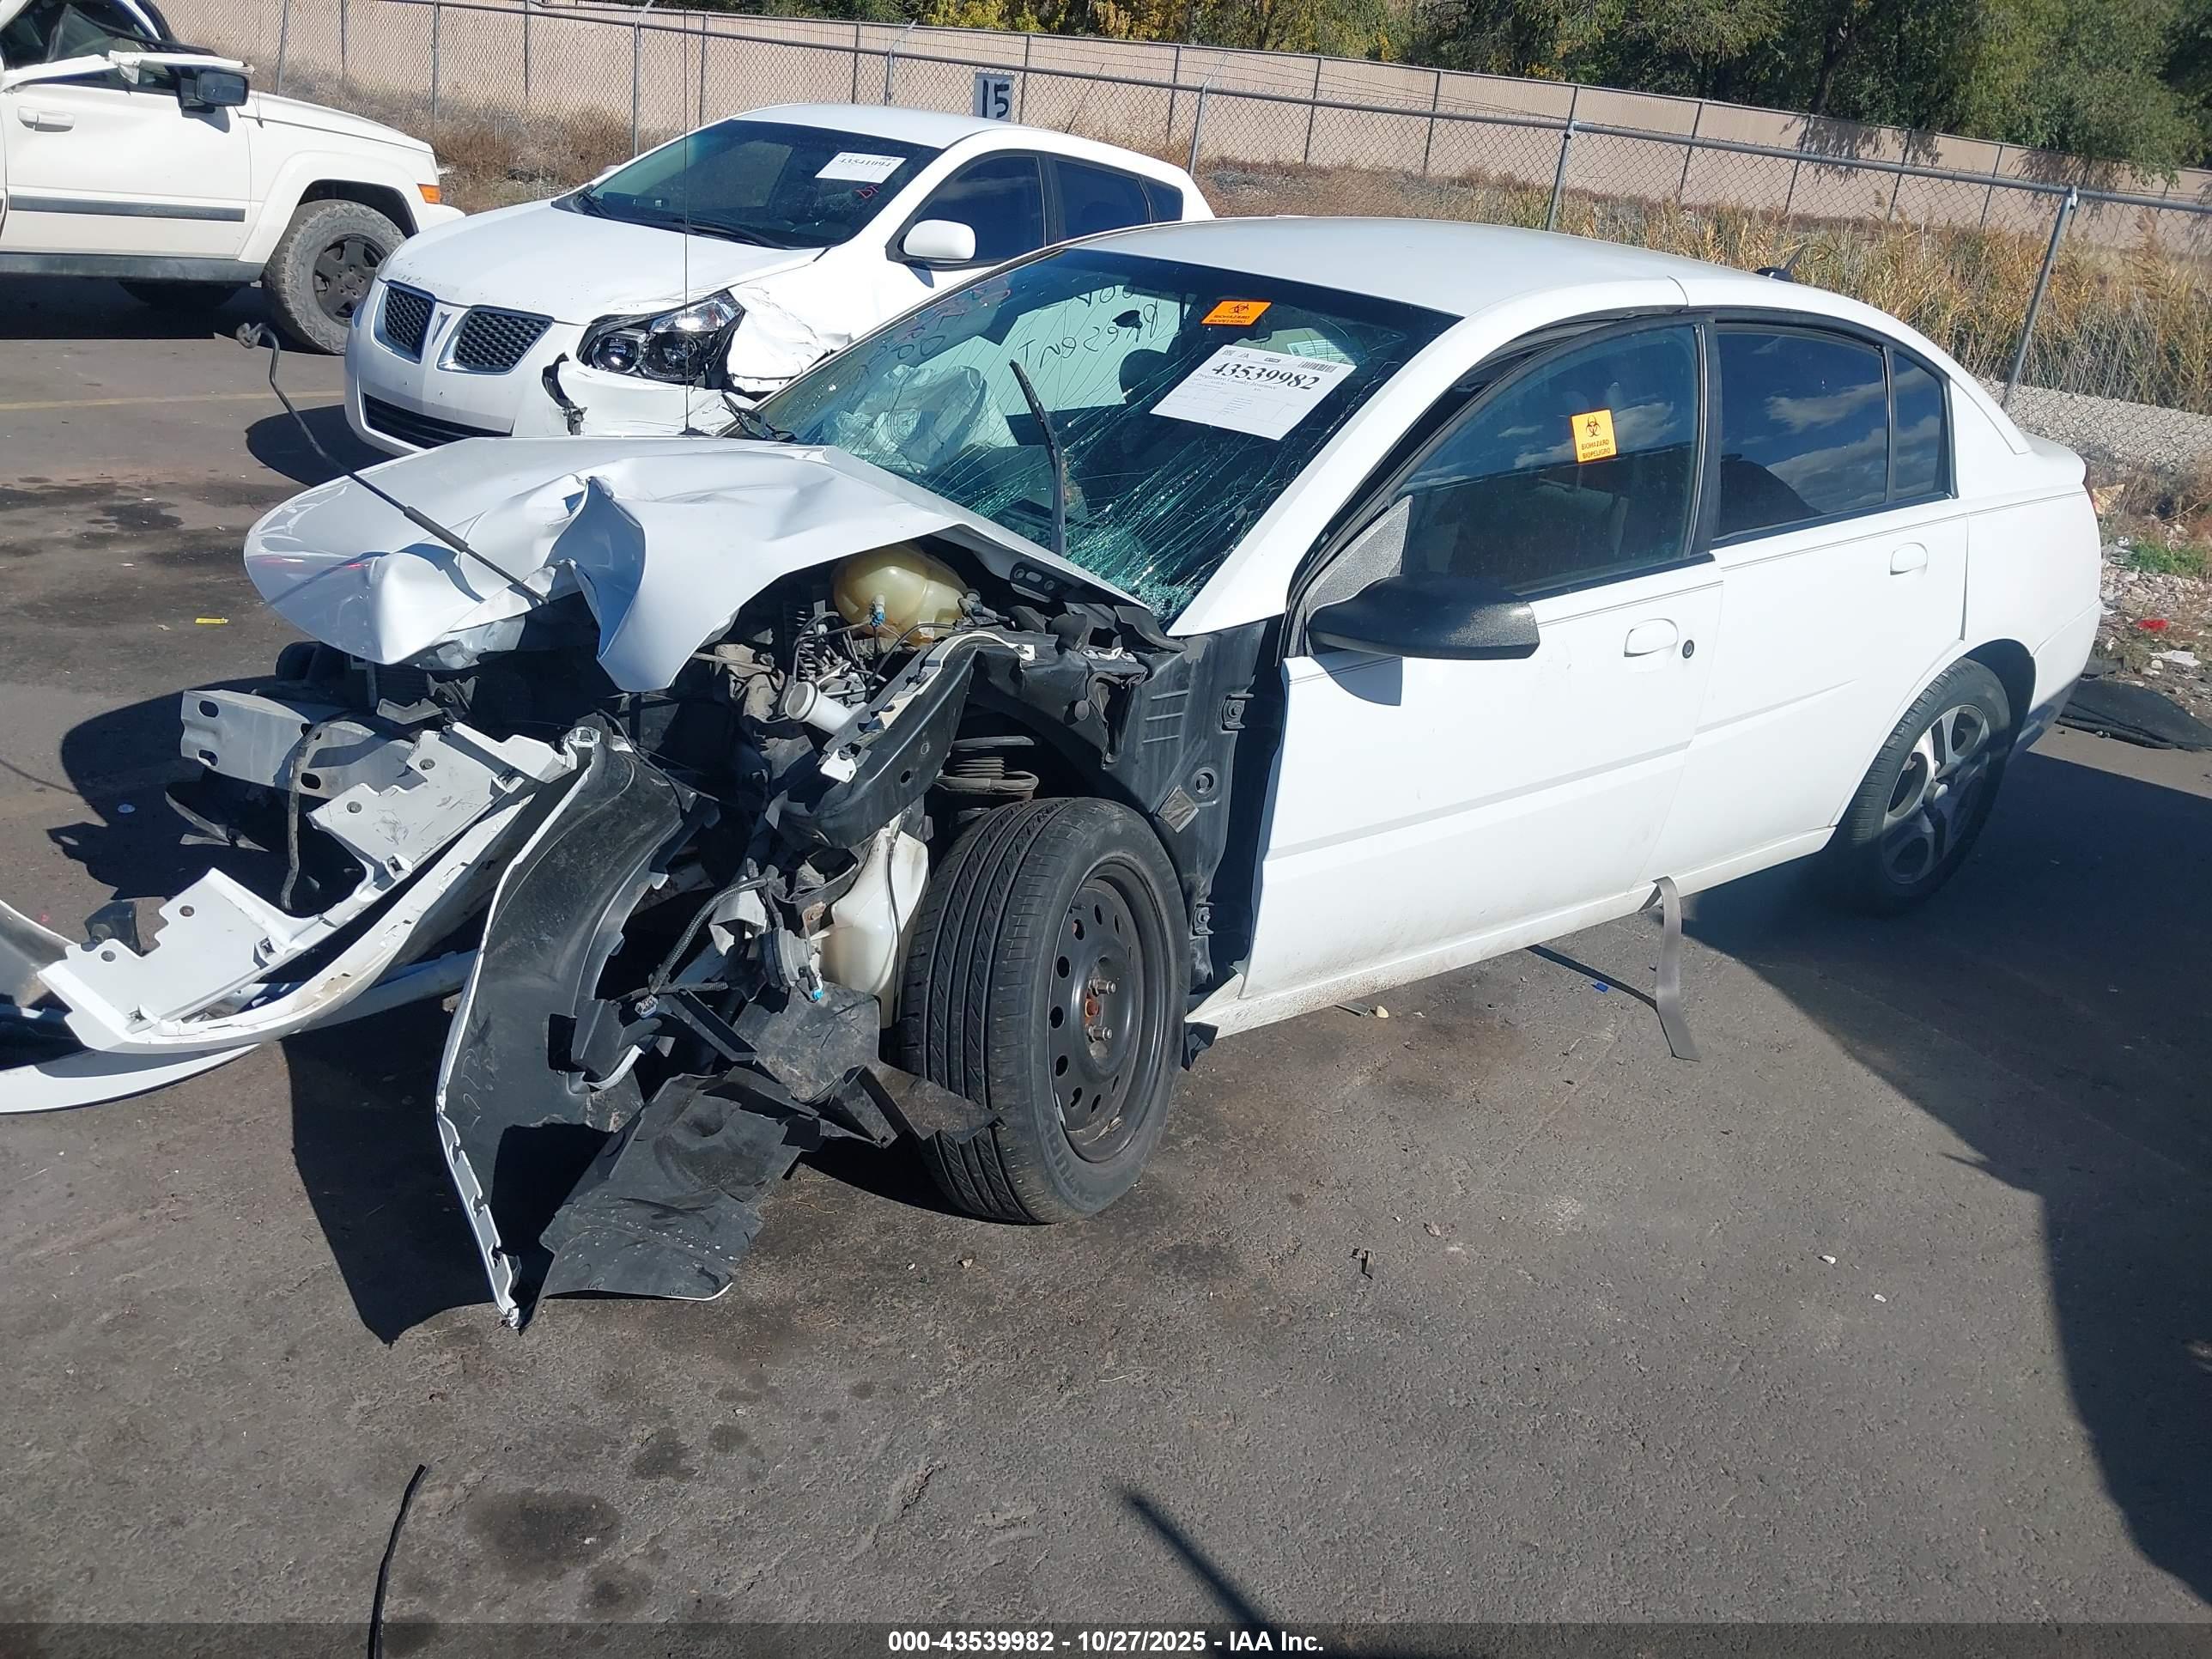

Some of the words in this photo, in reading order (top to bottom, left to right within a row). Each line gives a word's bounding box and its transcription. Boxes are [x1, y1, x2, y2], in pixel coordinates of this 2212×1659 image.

[981, 80, 1010, 118] 15
[1212, 362, 1321, 391] 43539982
[1581, 439, 1610, 450] BIOHAZARD
[1582, 447, 1611, 459] BIOPELIGRO
